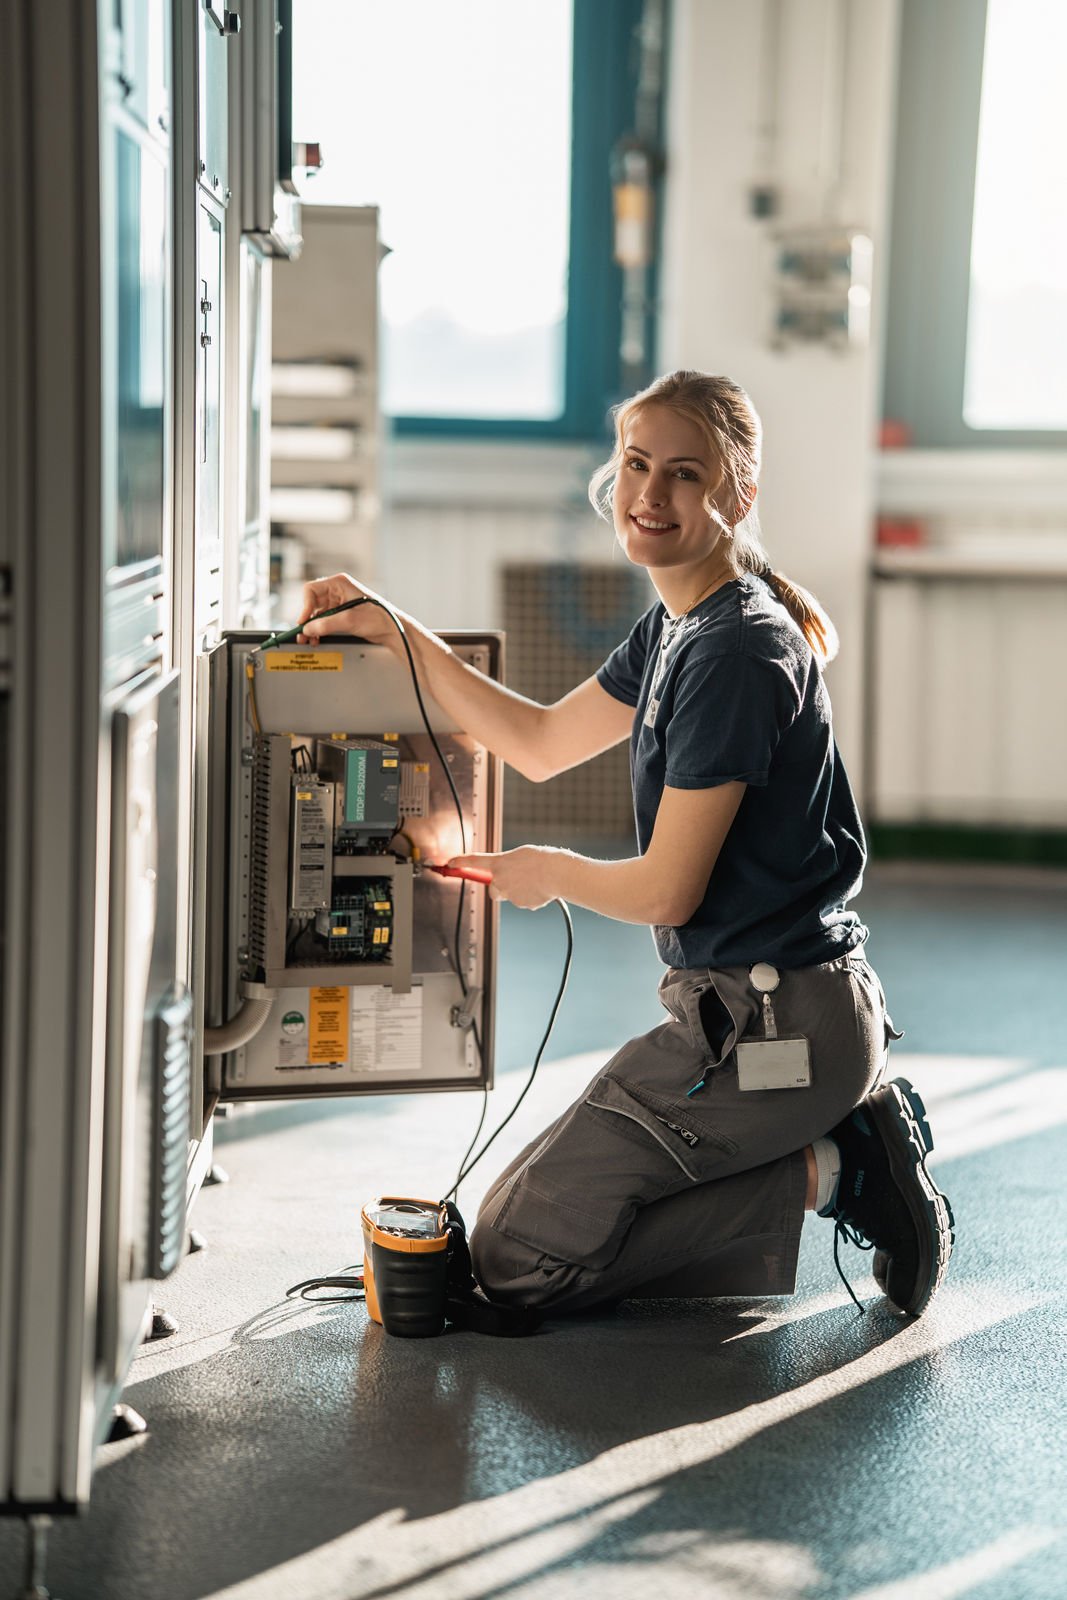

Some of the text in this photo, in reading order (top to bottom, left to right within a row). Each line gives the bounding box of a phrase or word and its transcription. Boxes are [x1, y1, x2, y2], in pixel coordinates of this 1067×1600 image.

[356, 756, 366, 820] SITOP PSU200M
[854, 1169, 865, 1197] atlas
